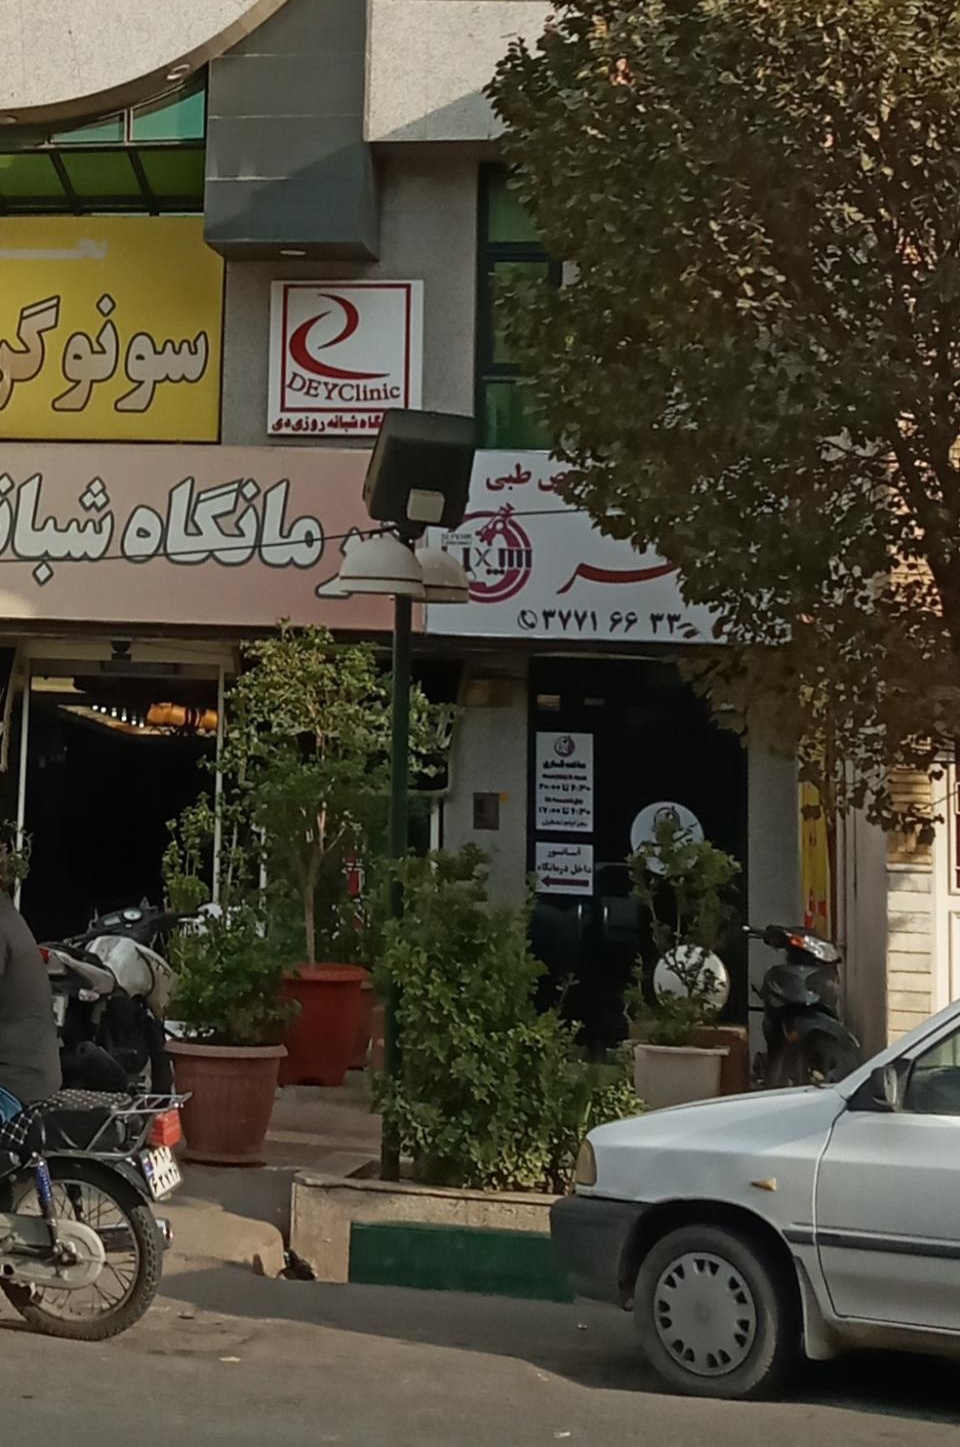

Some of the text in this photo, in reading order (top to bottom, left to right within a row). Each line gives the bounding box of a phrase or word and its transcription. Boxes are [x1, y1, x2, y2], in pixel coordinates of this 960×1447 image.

[286, 371, 402, 403] DEYClinic
[271, 417, 291, 432] دی
[485, 462, 532, 492] طبی
[120, 476, 392, 598] مانگاه
[542, 608, 599, 633] ۳۷۷۱
[609, 610, 639, 634] ۶۶
